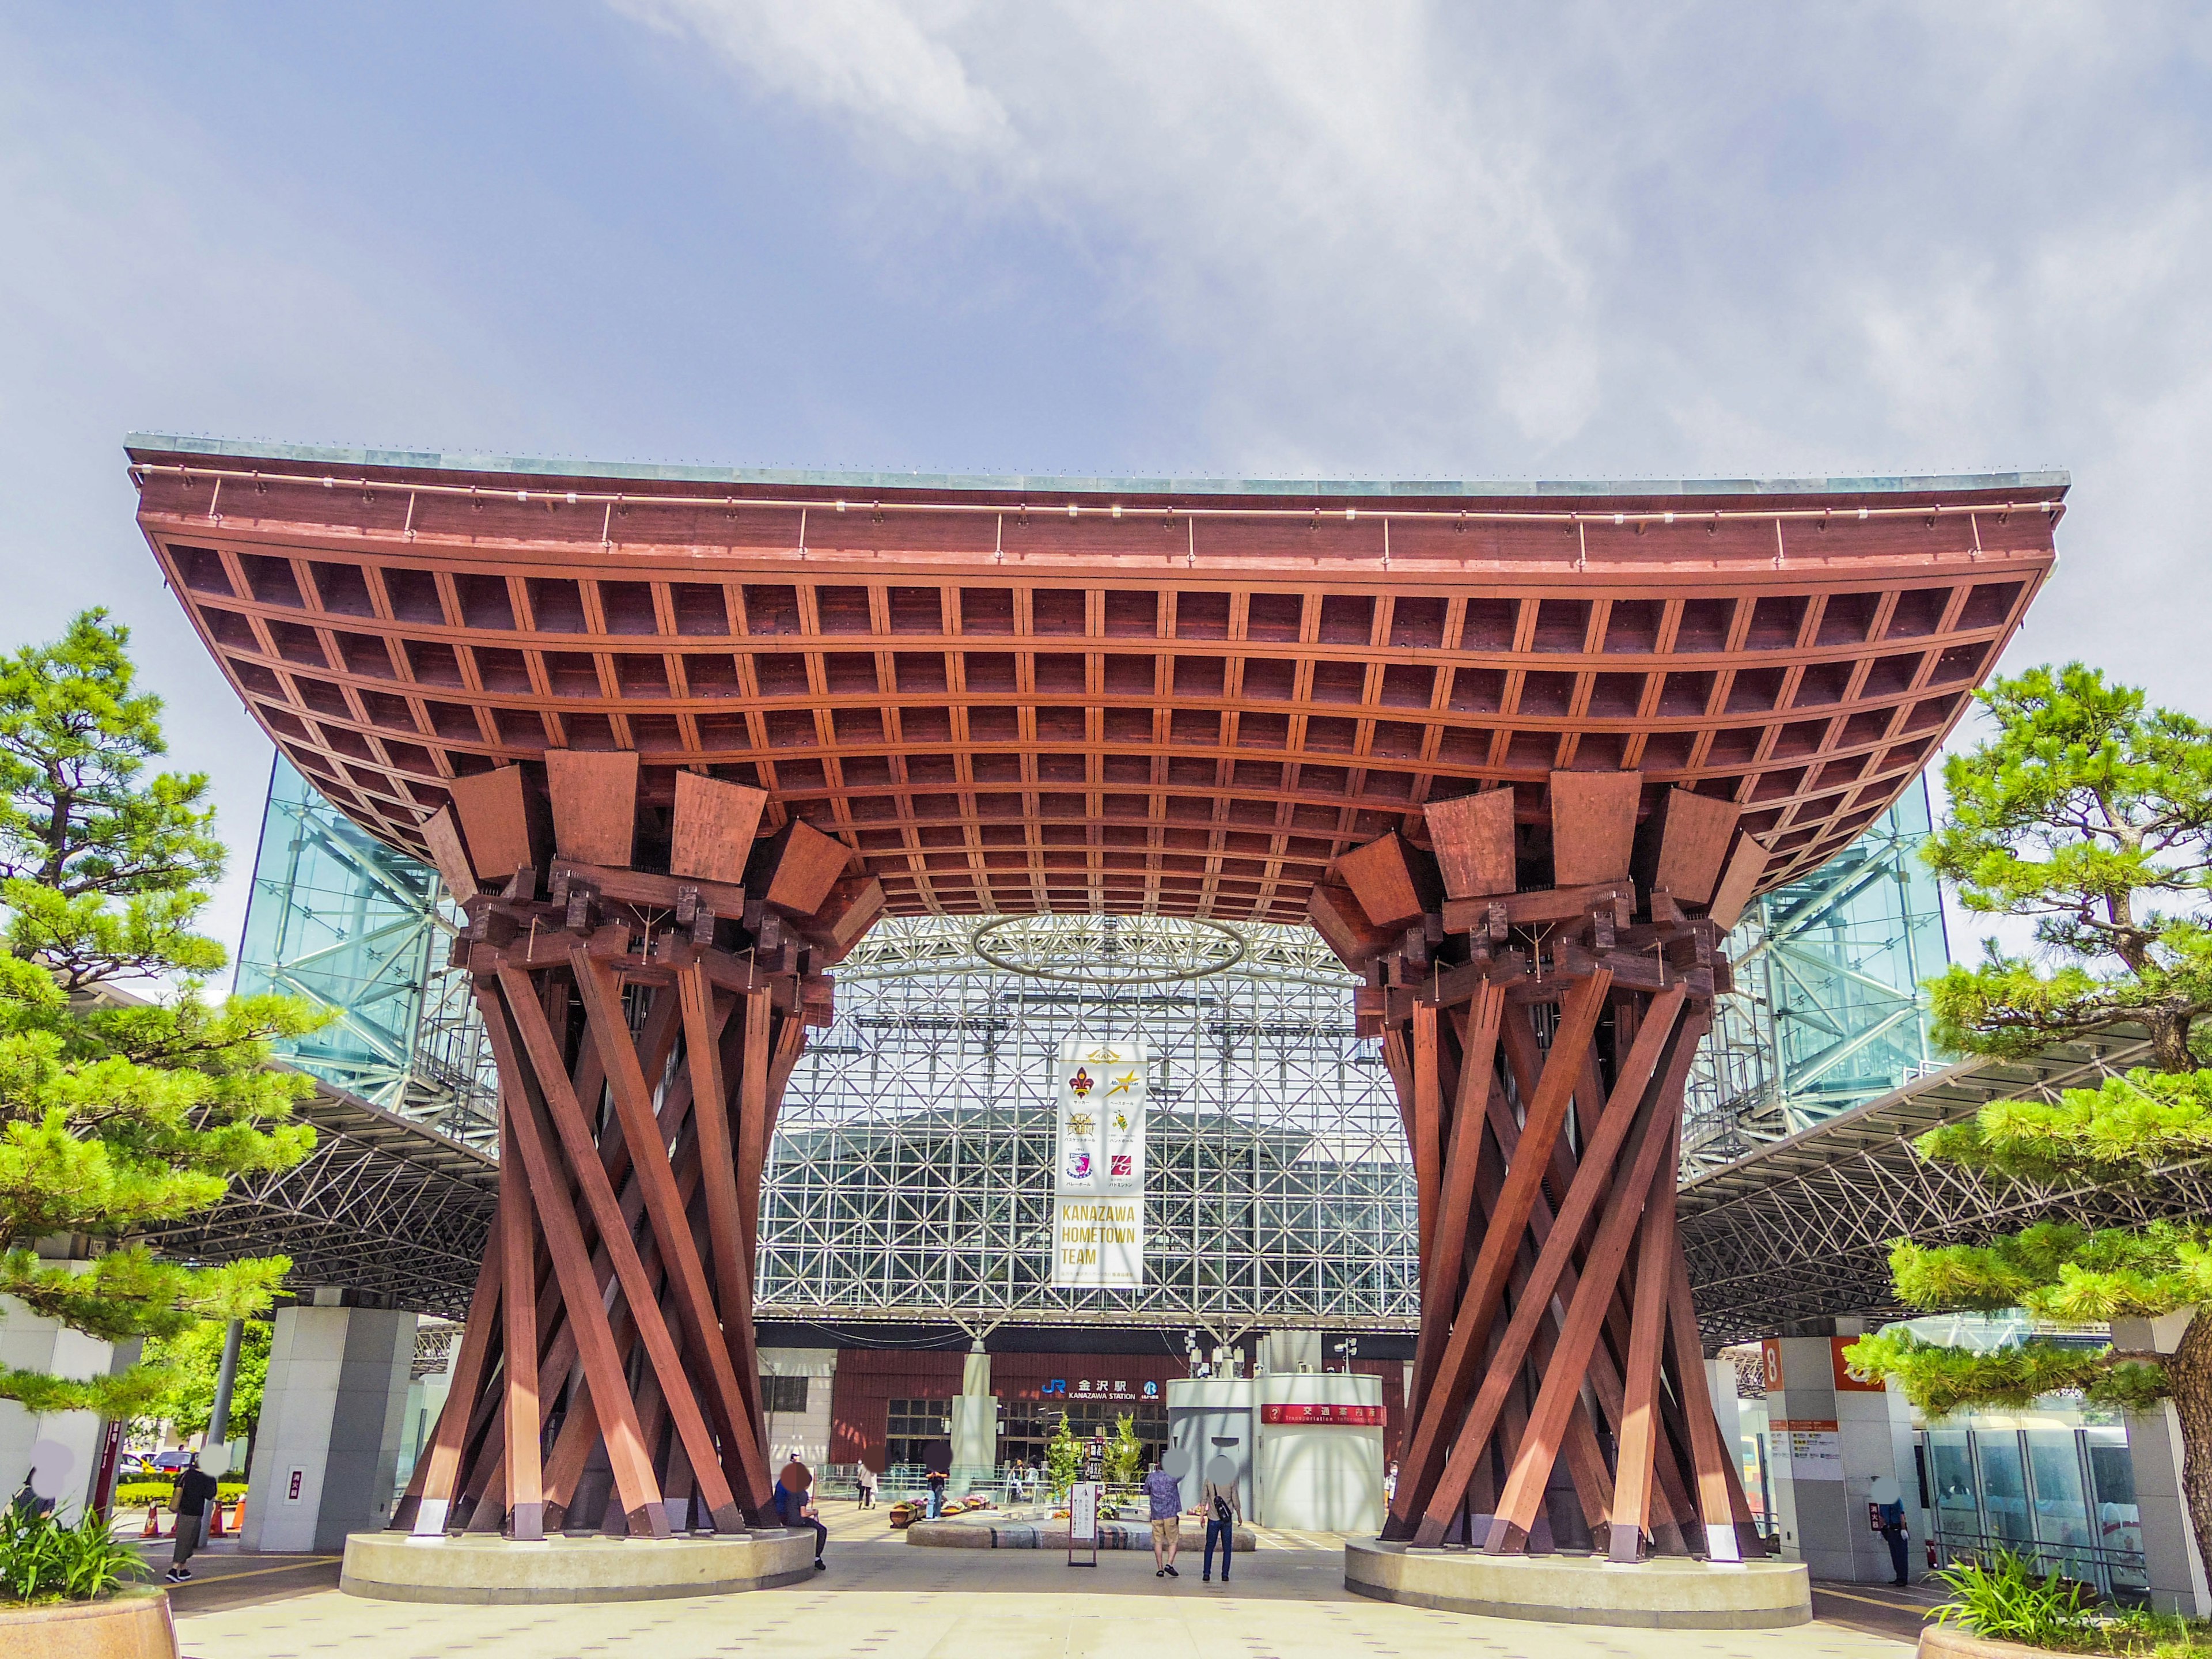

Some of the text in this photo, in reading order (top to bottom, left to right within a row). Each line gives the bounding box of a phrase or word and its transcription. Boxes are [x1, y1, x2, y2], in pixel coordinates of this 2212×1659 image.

[1063, 1205, 1135, 1222] KANAZAWA
[1062, 1227, 1135, 1243] HOMETOWN
[1061, 1248, 1096, 1265] TEAM
[1767, 1347, 1778, 1382] 8
[1042, 1379, 1066, 1394] JR
[1078, 1379, 1127, 1392] 金沢駅
[1303, 1406, 1376, 1417] 交通案内所
